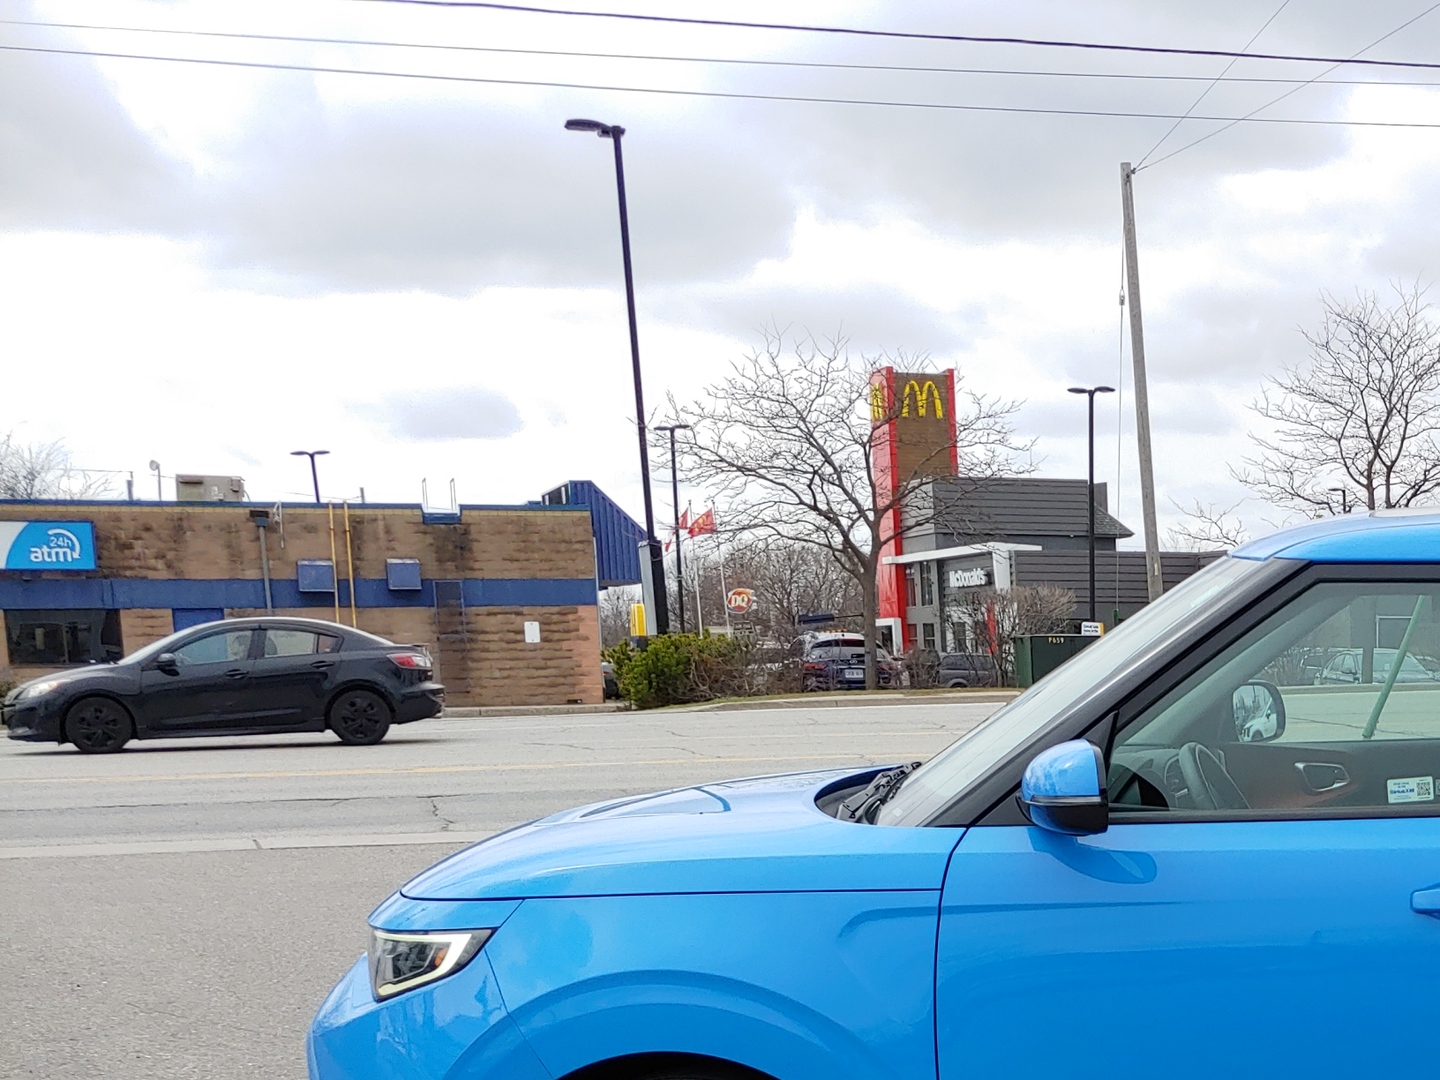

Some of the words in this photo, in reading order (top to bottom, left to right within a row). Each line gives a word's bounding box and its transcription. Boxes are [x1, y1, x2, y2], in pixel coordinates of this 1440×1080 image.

[50, 537, 72, 547] 24h
[30, 545, 72, 562] atm
[731, 594, 748, 608] DQ
